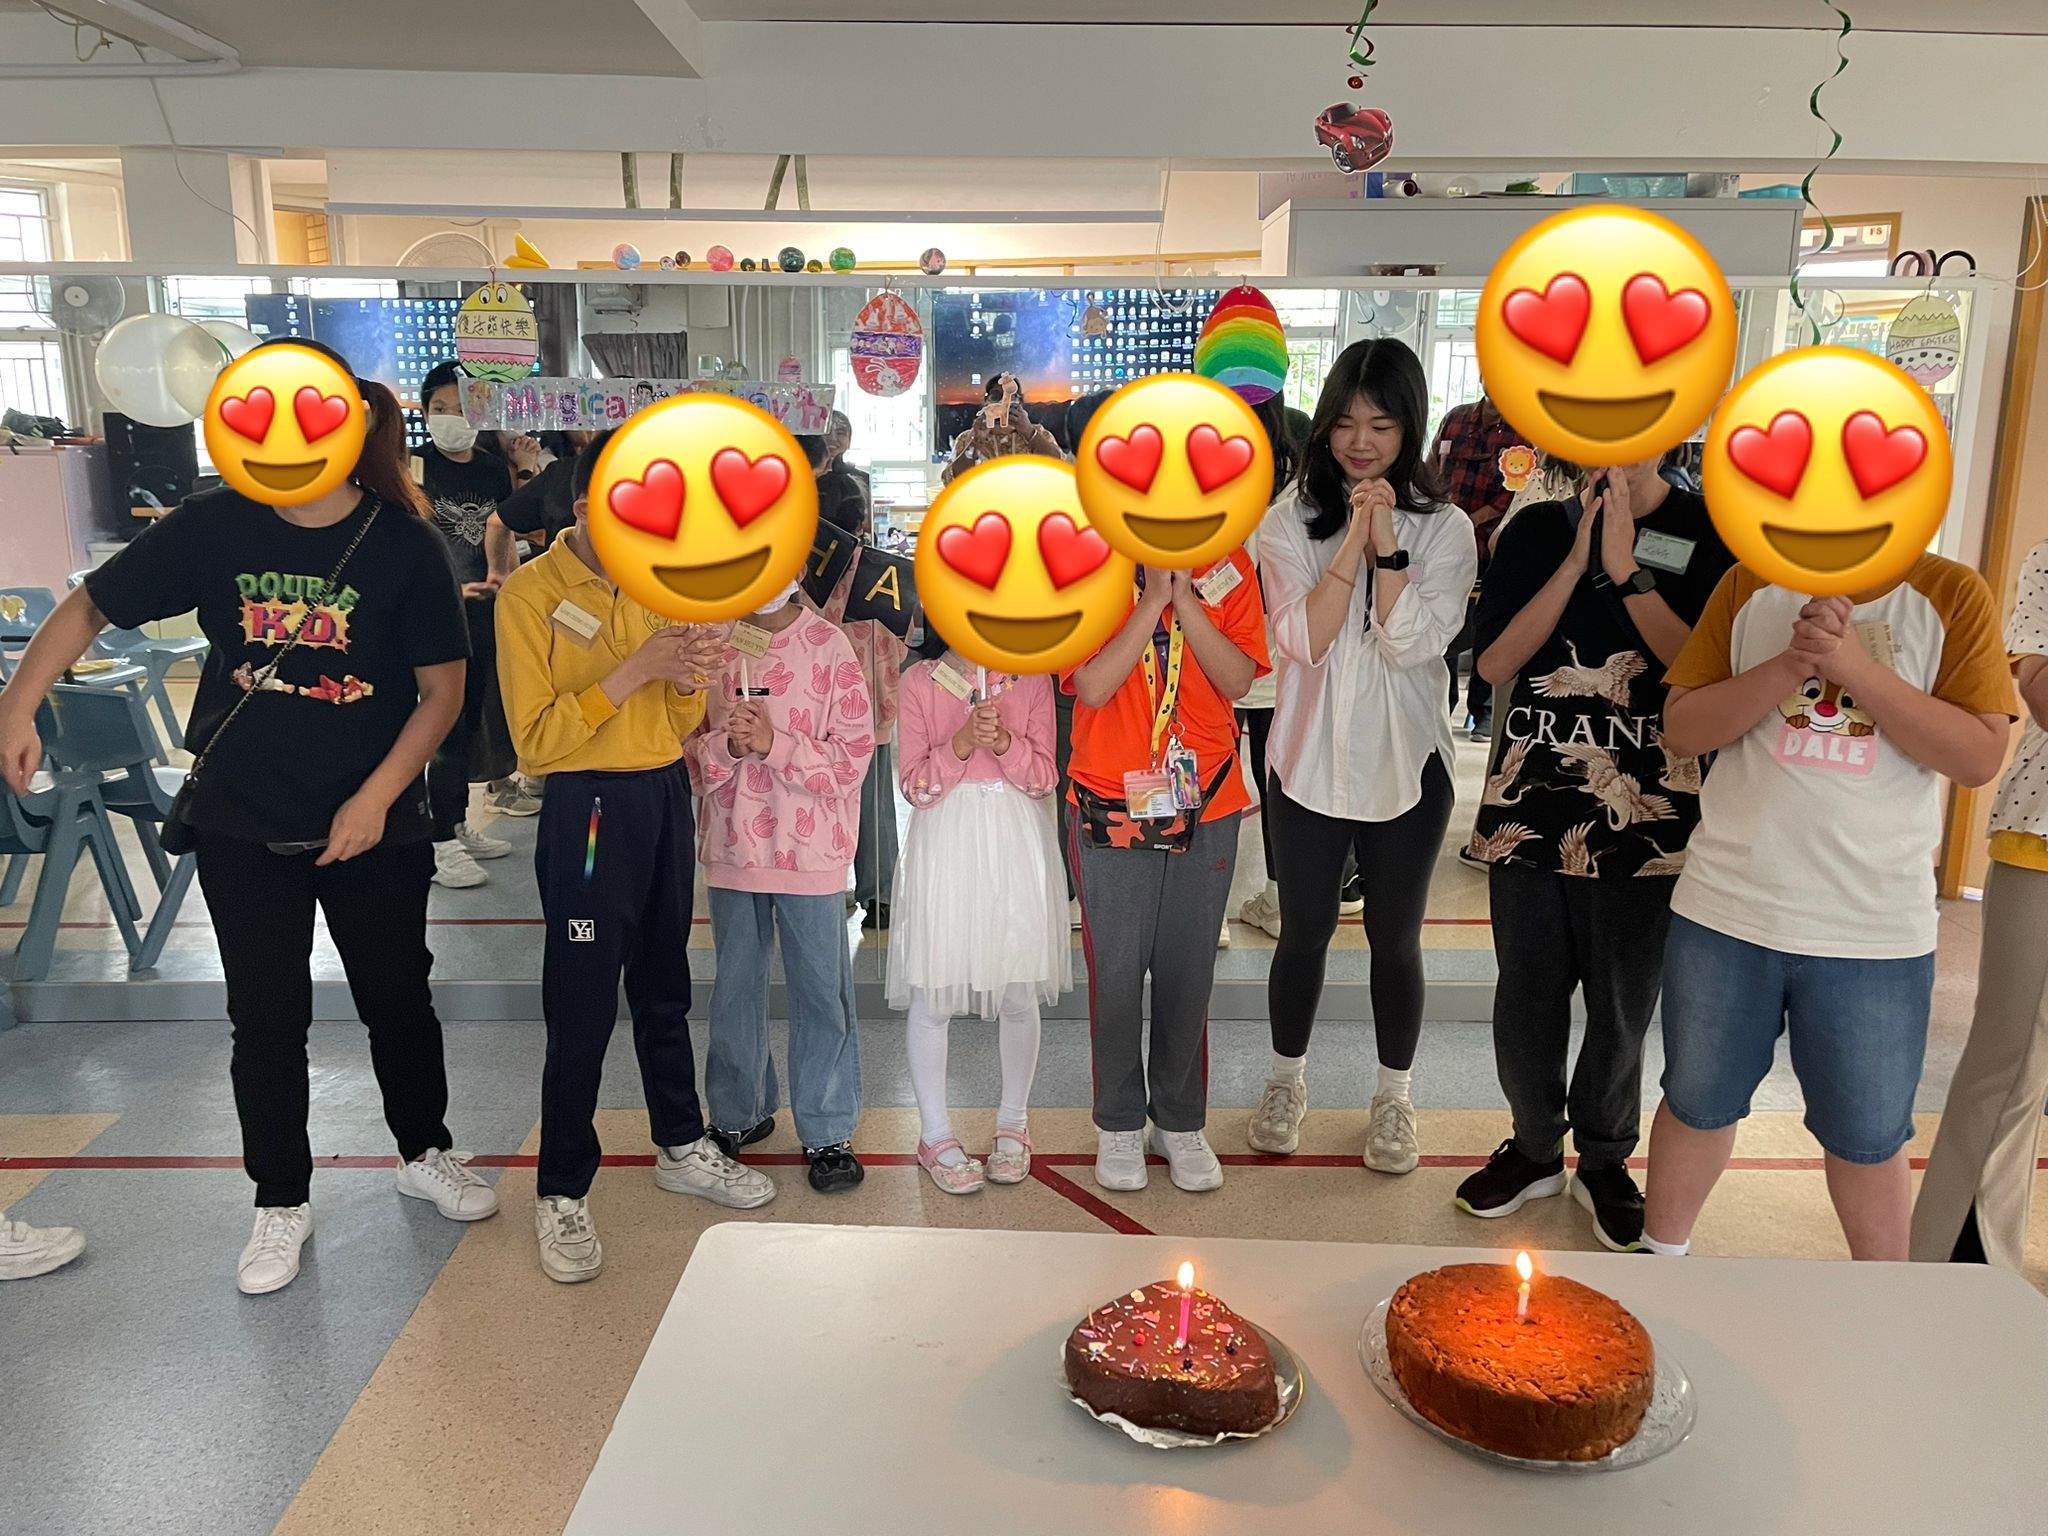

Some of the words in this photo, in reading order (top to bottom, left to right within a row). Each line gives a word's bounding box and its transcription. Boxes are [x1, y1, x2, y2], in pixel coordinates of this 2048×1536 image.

[1889, 338, 1916, 351] HAPPY
[1920, 334, 1956, 347] EASTER
[1783, 731, 1868, 766] DALE
